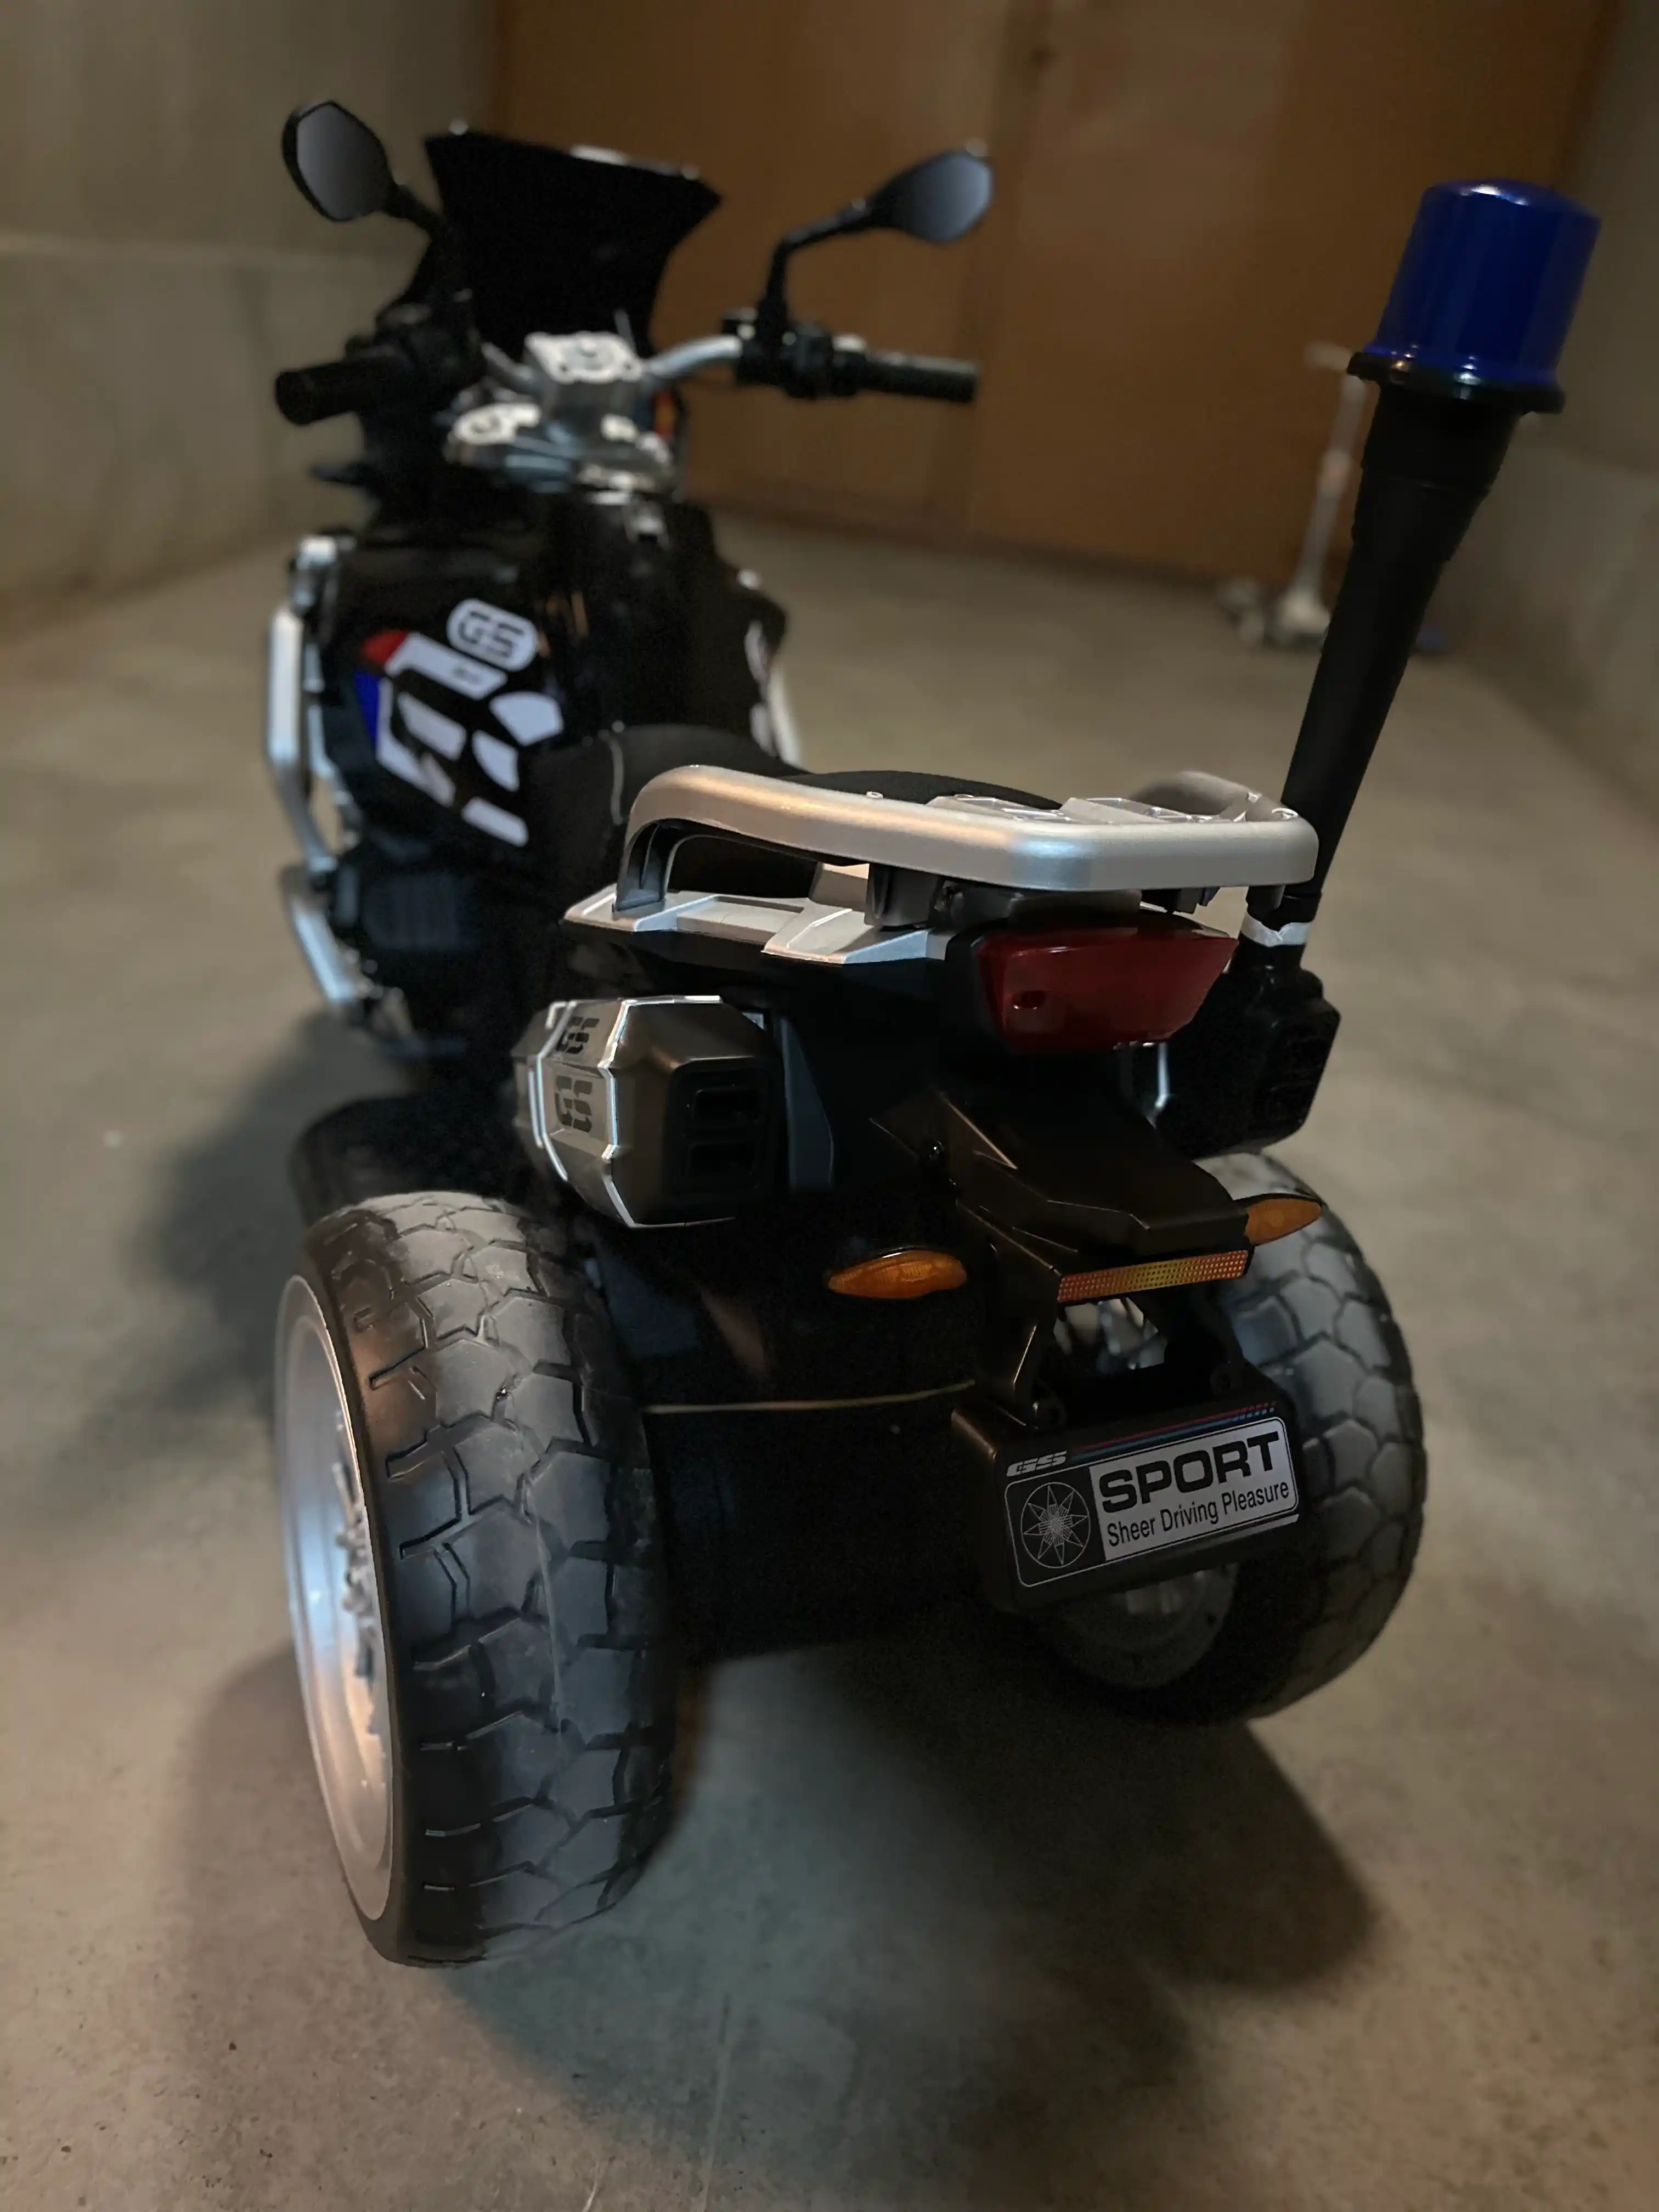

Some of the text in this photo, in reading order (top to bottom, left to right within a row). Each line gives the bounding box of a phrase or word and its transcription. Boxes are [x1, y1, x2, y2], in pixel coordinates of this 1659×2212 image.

[457, 609, 526, 658] GS
[1006, 1450, 1068, 1477] GS
[1098, 1431, 1279, 1513] SPORT
[1107, 1480, 1290, 1547] Sheer Driving Pleasure
